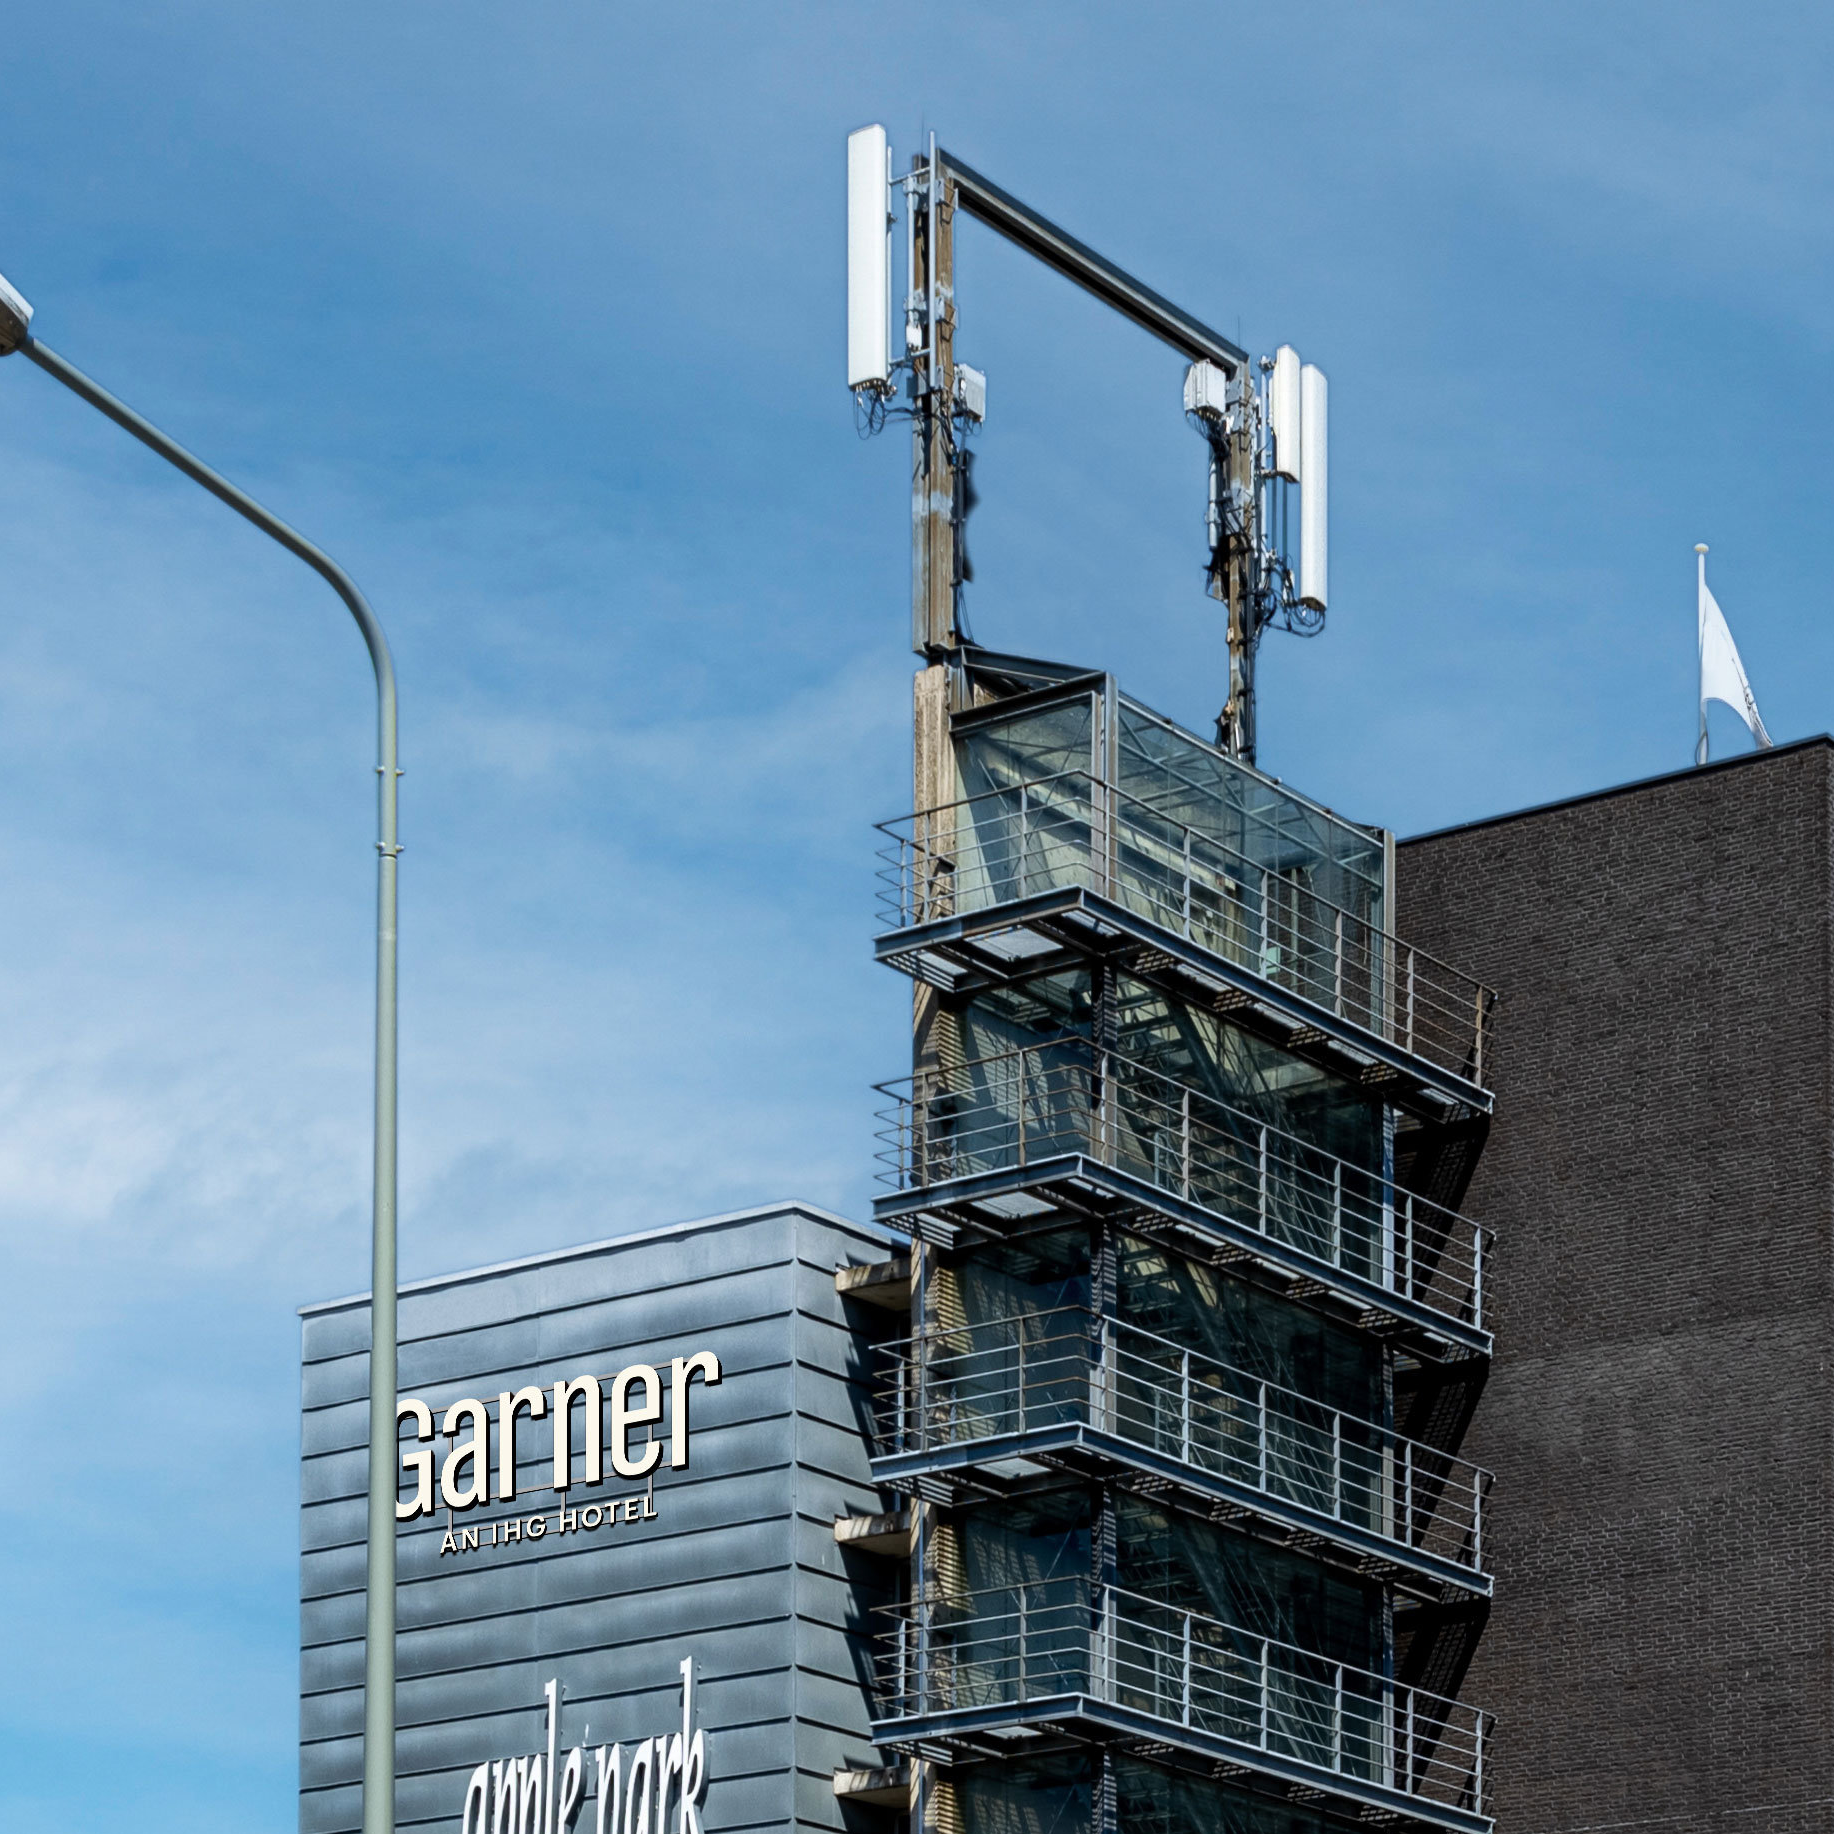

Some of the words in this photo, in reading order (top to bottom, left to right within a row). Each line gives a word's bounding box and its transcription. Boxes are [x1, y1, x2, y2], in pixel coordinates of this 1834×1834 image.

[396, 1350, 721, 1521] Garner
[439, 1526, 479, 1555] AN
[492, 1515, 547, 1545] IHG
[559, 1496, 658, 1533] HOTEL
